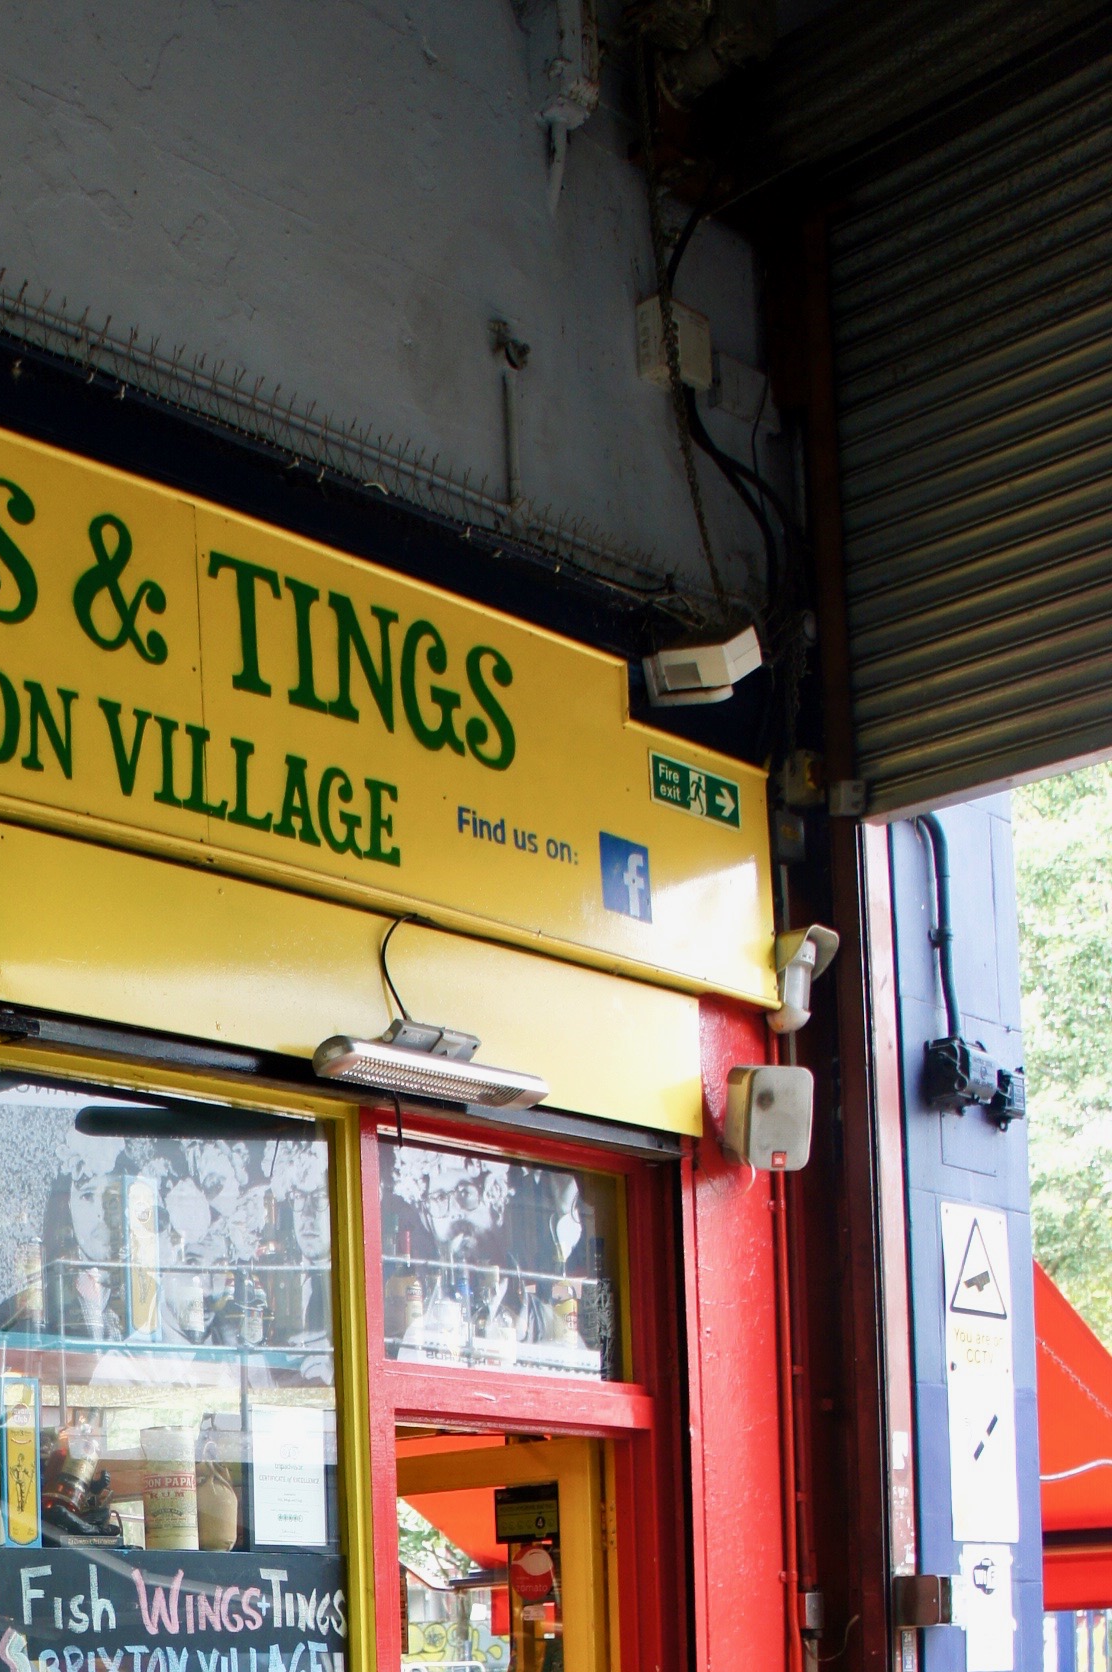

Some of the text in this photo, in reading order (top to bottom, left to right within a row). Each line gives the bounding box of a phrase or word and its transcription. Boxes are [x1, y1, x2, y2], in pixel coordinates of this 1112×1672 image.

[72, 513, 168, 666] &
[208, 550, 516, 771] TINGS
[97, 697, 401, 867] VILLAGE
[658, 761, 680, 783] Fire
[659, 783, 681, 802] exit
[456, 805, 580, 865] Find us on:
[954, 1328, 973, 1343] You
[165, 1477, 191, 1486] PAPA
[20, 1563, 116, 1634] Fish
[131, 1568, 263, 1636] WINGS
[260, 1567, 348, 1638] TINGS
